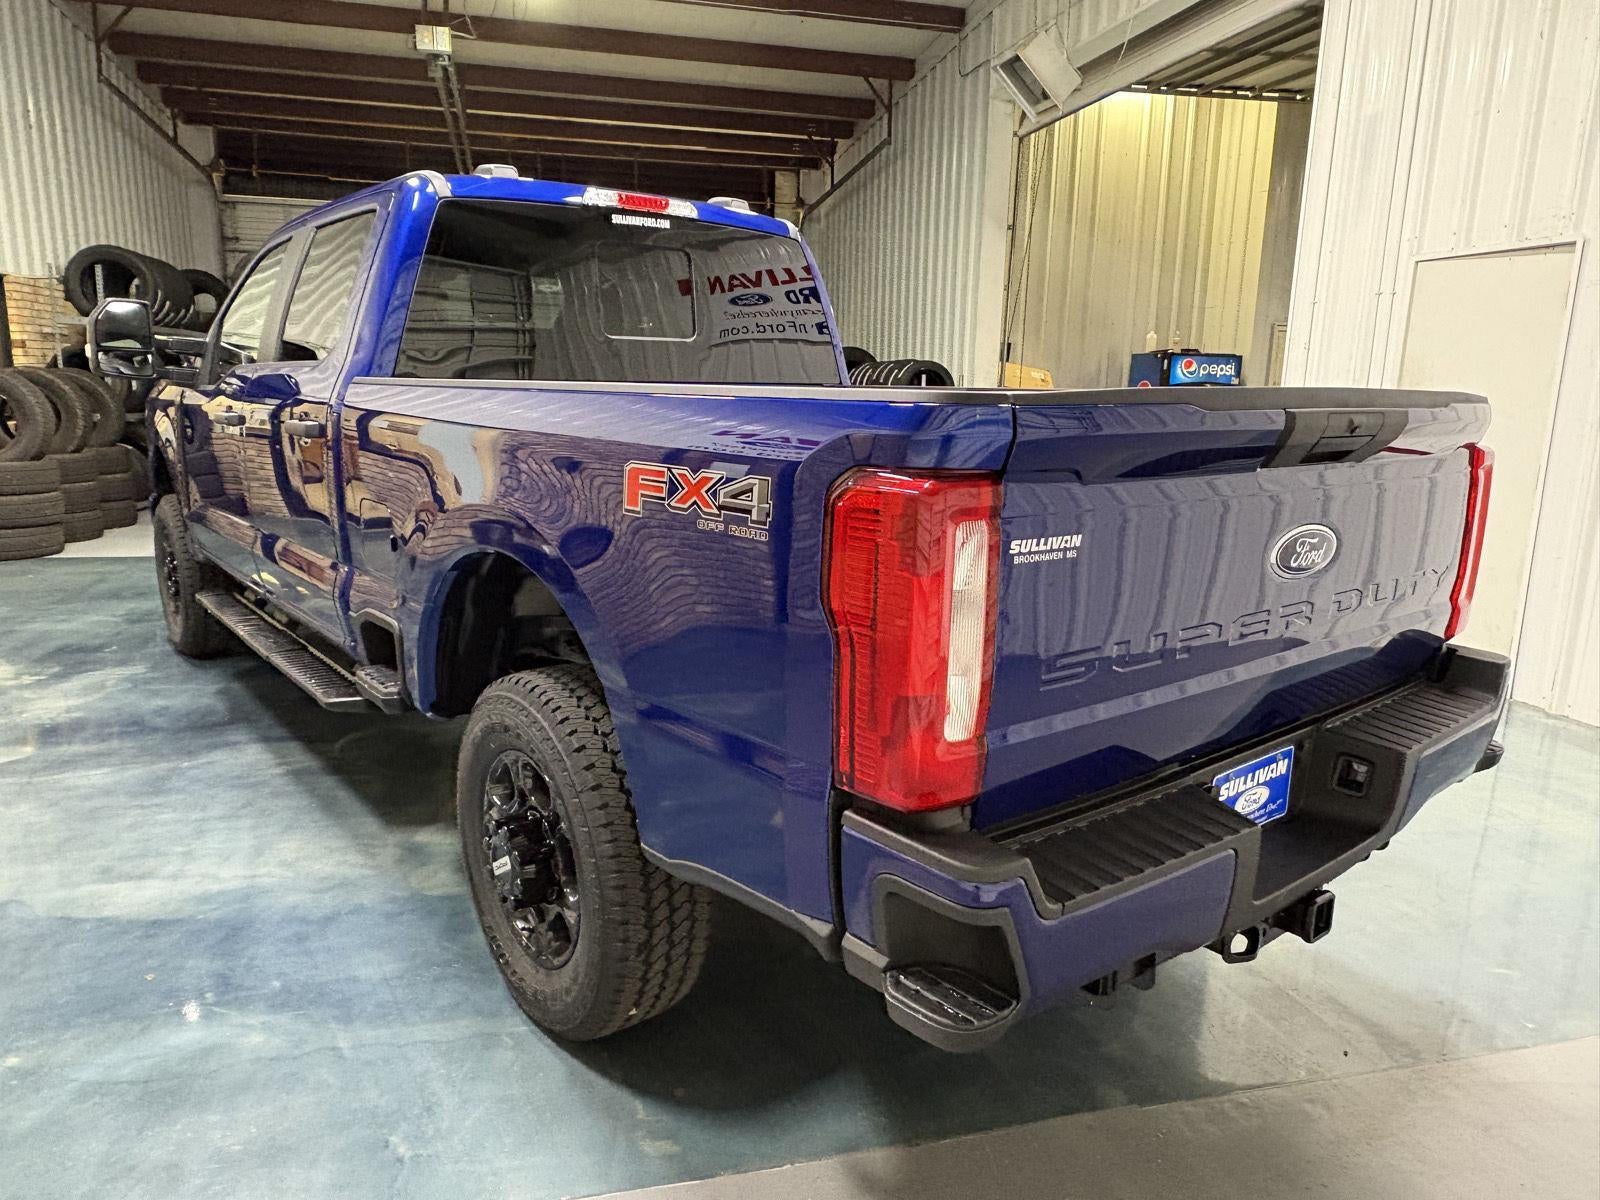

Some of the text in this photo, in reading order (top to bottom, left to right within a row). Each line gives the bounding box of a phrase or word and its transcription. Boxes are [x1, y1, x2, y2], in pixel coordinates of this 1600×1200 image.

[611, 213, 671, 229] SULLIVANFORD.COM
[1199, 362, 1235, 377] pepsi
[623, 460, 772, 528] FX4
[697, 519, 769, 541] OFF ROAD
[1009, 534, 1082, 554] SULLIVAN
[1290, 537, 1327, 568] Ford
[1013, 549, 1077, 565] BROOKHAVEN MS
[1040, 565, 1449, 692] SUPER DUTY
[1218, 758, 1289, 802] SULLIVAN
